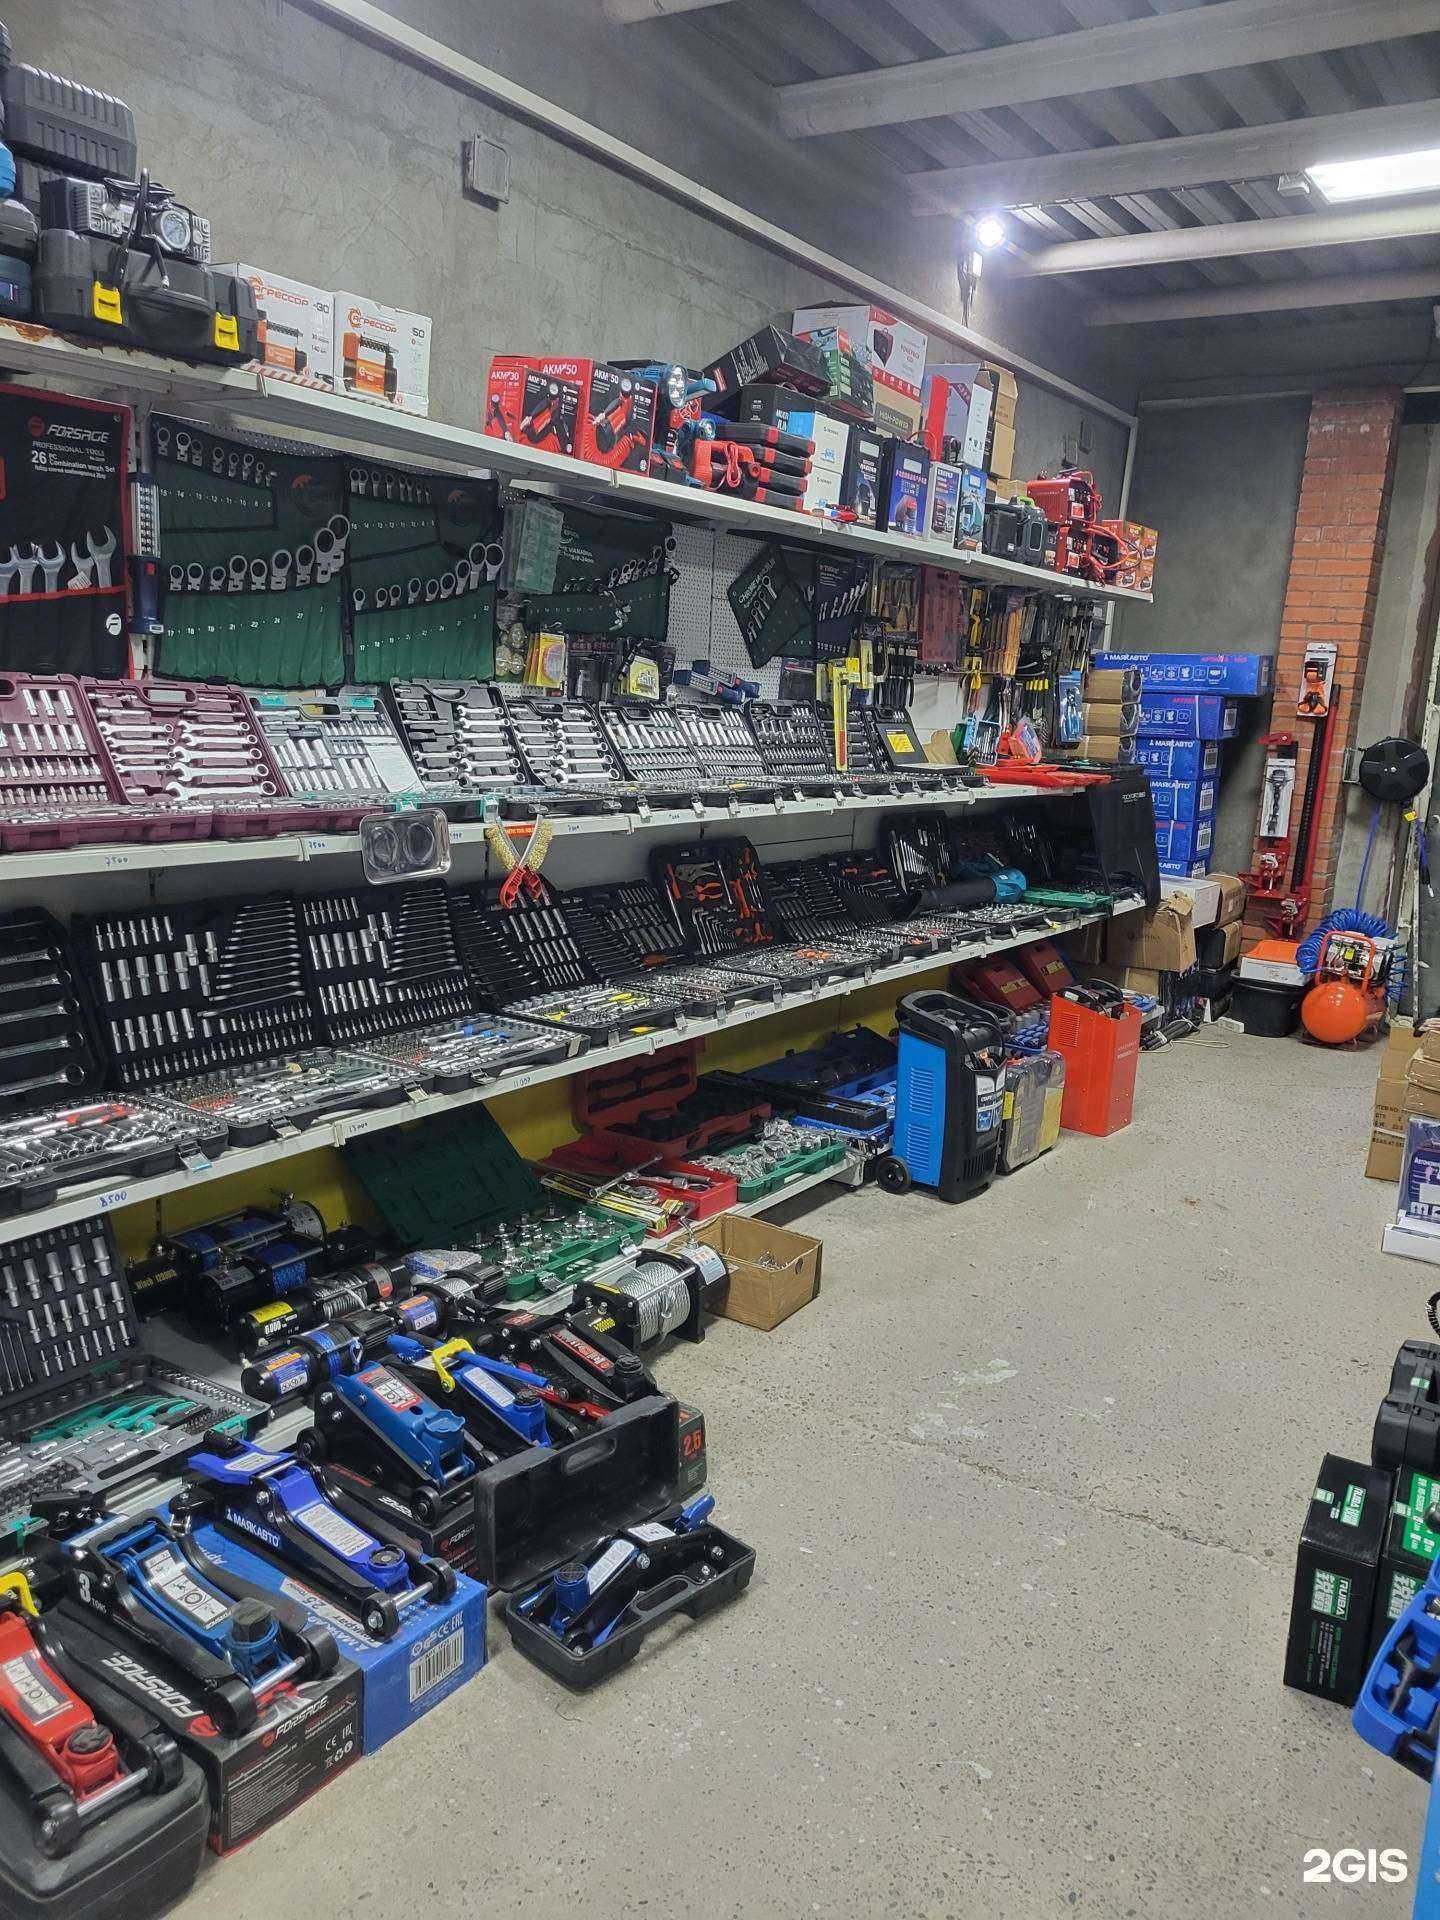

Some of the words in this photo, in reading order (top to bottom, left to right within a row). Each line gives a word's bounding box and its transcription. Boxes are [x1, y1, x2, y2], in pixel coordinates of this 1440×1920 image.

[32, 441, 85, 454] PROFESSIONAL
[47, 424, 110, 443] FORSAGE
[31, 450, 47, 464] 26
[49, 460, 87, 470] Combination
[233, 1512, 279, 1547] МАЯКАВТО
[79, 1572, 91, 1603] 3
[1336, 1579, 1350, 1616] RUIBA
[101, 1654, 204, 1719] FORSAGE
[275, 1695, 329, 1740] FORSAGE
